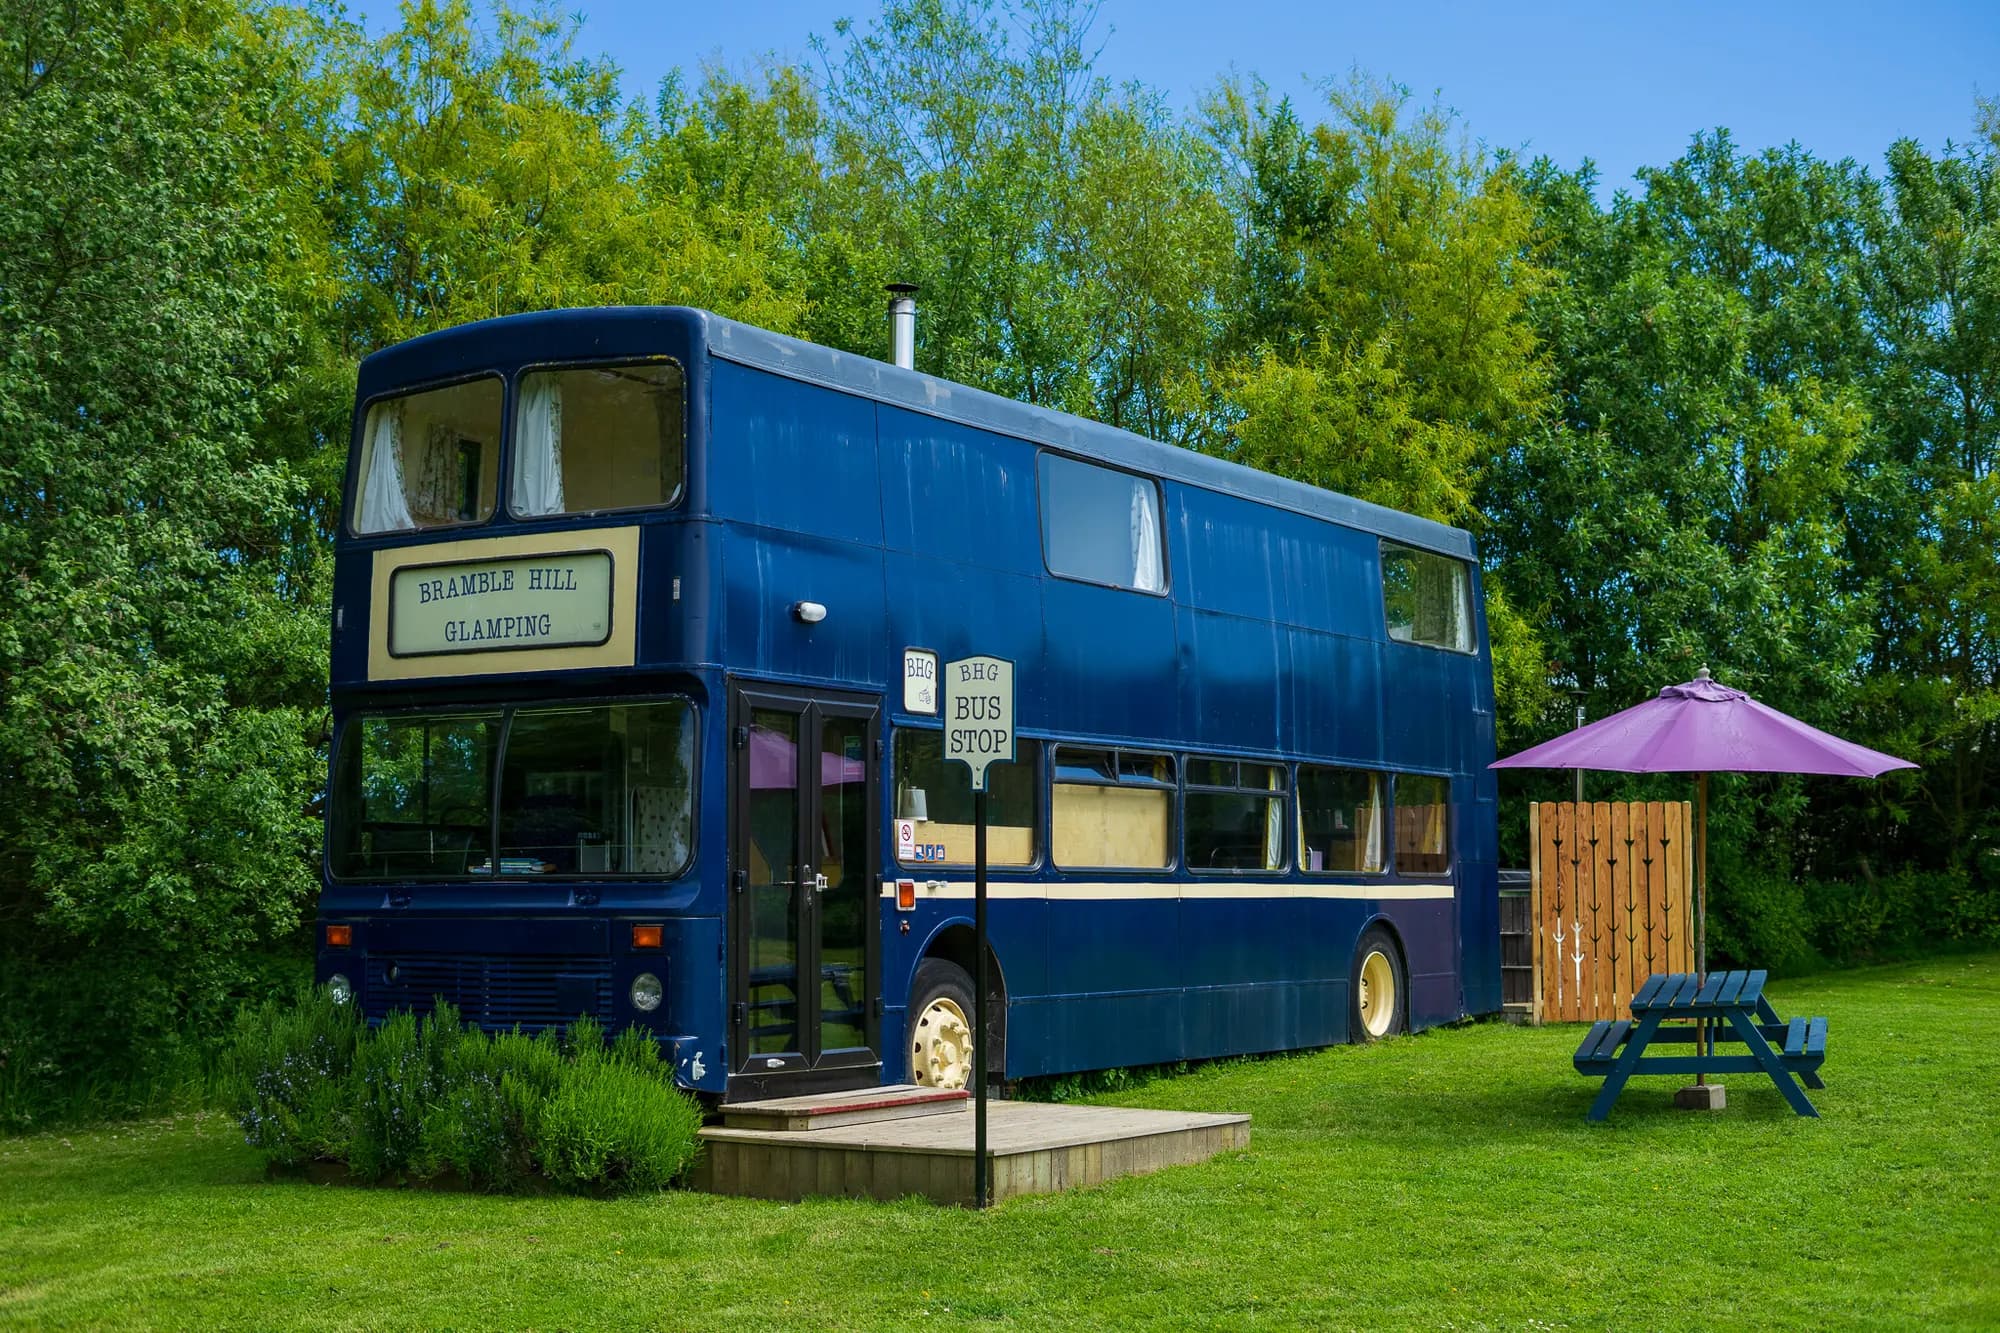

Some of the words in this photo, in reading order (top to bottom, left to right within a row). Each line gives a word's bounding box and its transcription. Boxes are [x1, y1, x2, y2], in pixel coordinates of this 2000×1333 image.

[419, 570, 514, 604] BRAMBLE
[528, 569, 577, 591] HILL
[445, 614, 551, 642] GLAMPING
[906, 658, 934, 679] BHG
[960, 663, 999, 682] BHG
[955, 696, 1001, 720] BUS
[950, 729, 1008, 753] STOP
